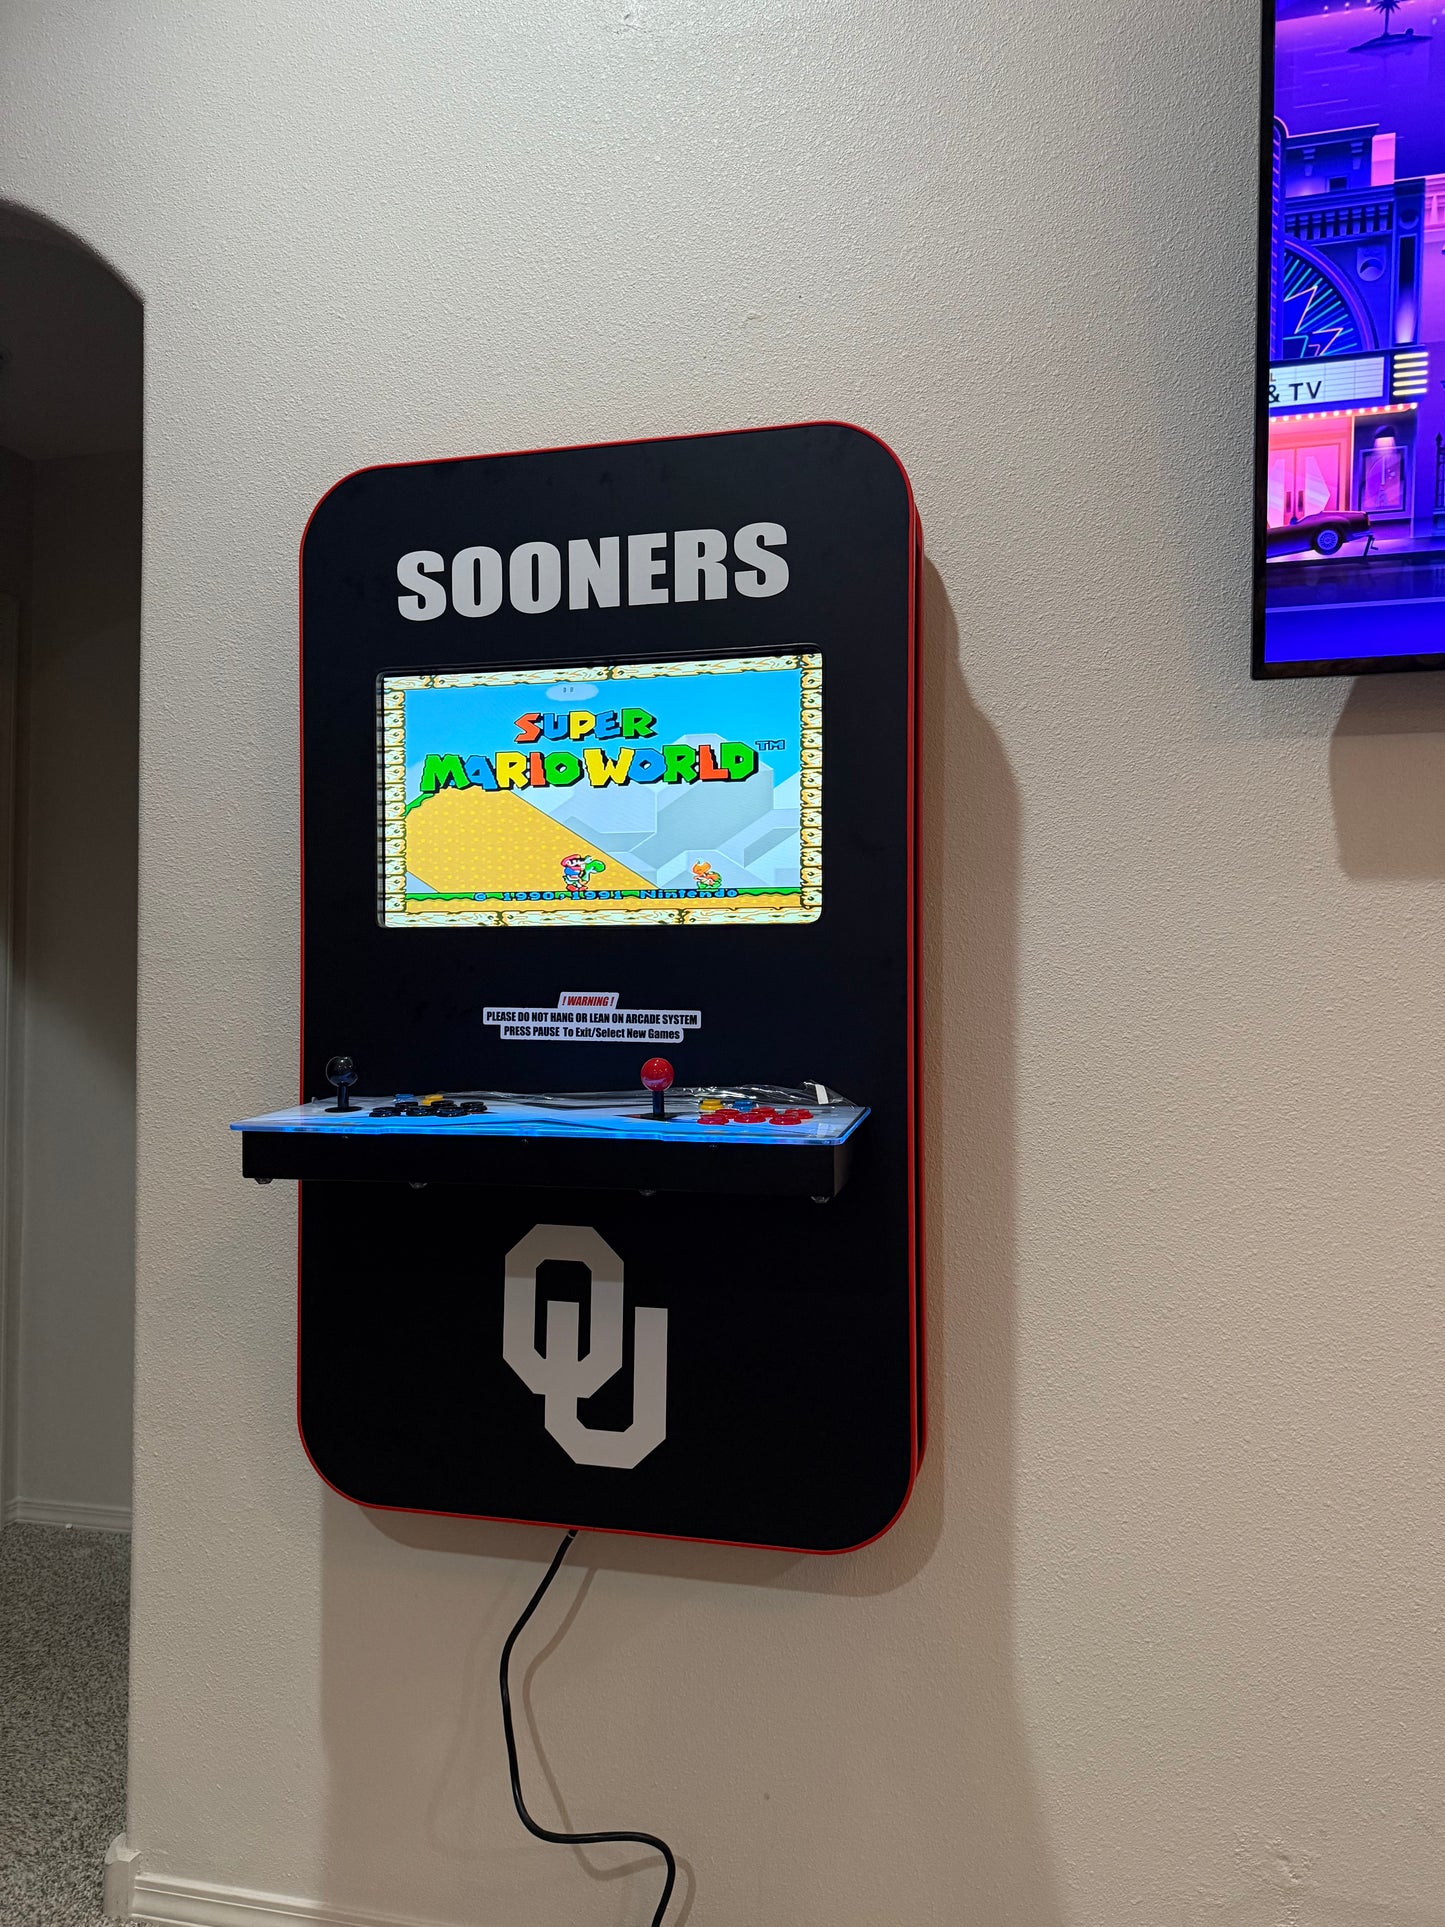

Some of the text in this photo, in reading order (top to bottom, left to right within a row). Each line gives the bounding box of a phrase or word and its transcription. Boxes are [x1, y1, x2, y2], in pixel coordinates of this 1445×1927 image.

[1288, 381, 1322, 401] TV
[396, 522, 790, 622] SOONERS
[514, 707, 657, 744] SUPER
[419, 751, 584, 793] MARIO
[583, 741, 760, 788] WORLD
[640, 888, 739, 900] Nintendo
[567, 996, 609, 1007] WARNING
[486, 1011, 698, 1025] PLEASE DO NOT HANG OR LEAN ON ARCADE SYSTEM
[504, 1026, 680, 1039] PRESS PAUSE To Exit/Select New Games
[503, 1224, 668, 1469] OU
